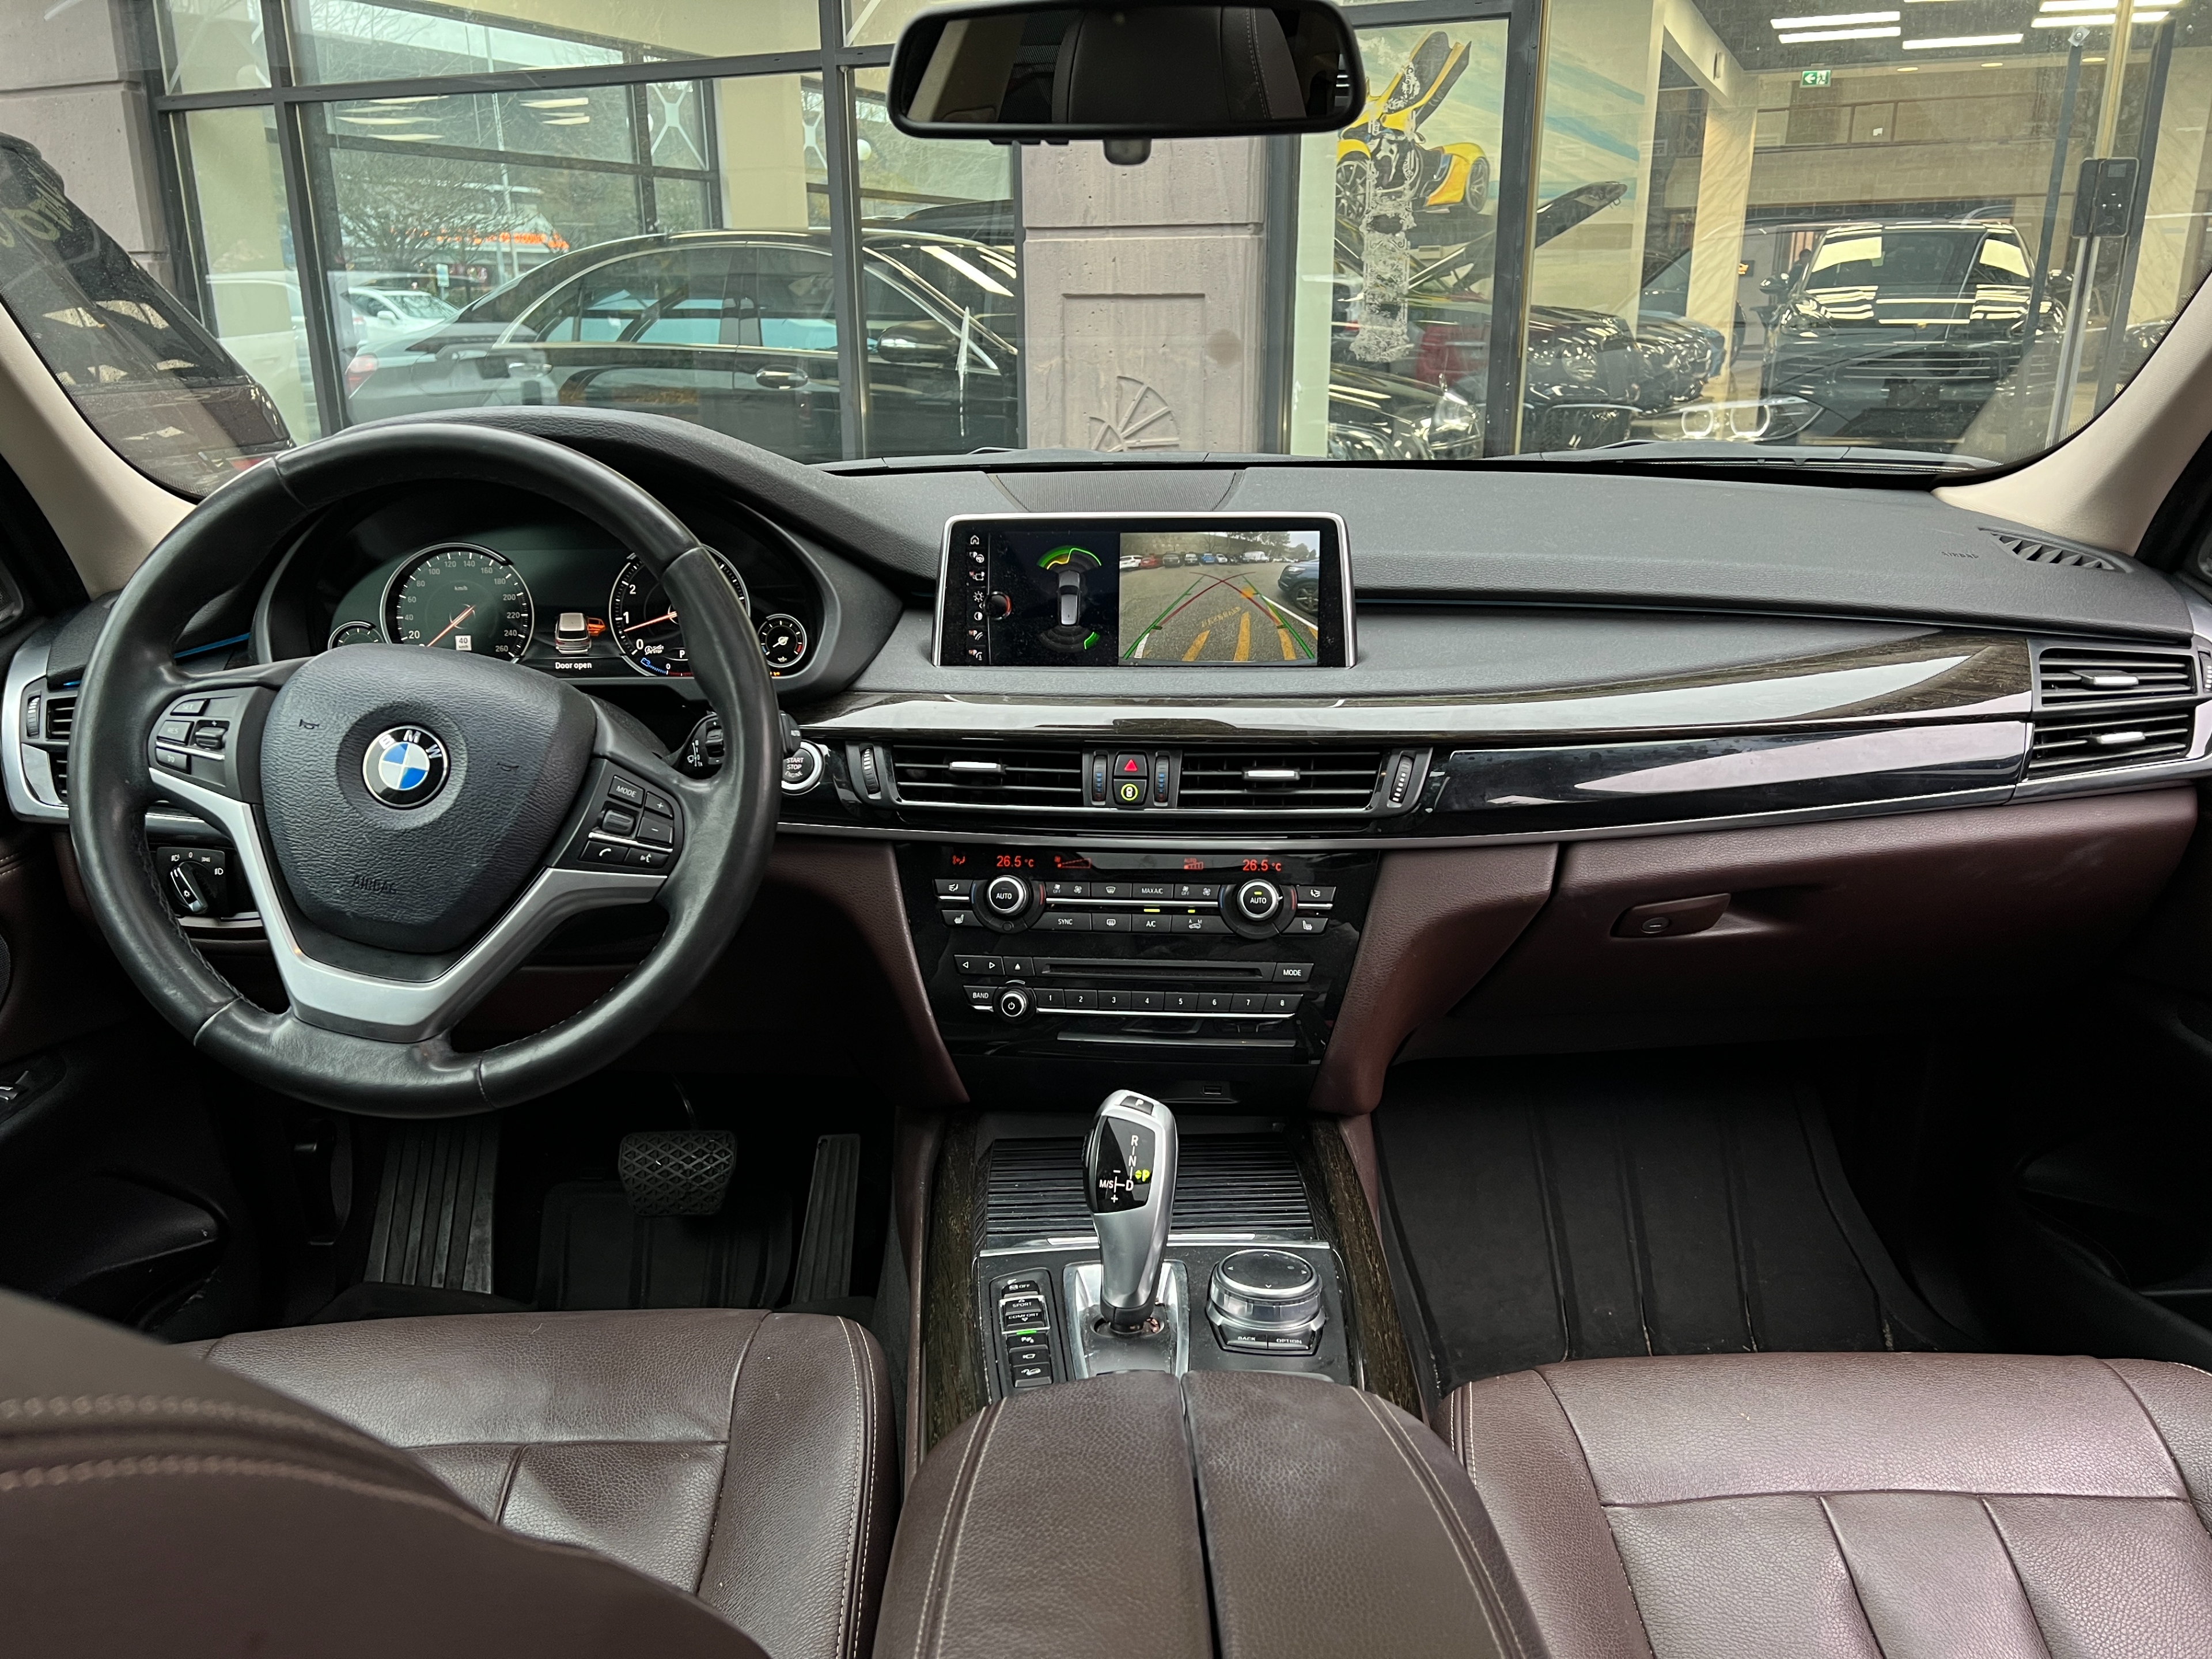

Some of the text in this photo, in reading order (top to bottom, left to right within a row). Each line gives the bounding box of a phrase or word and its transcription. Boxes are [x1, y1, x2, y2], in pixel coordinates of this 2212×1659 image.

[629, 585, 636, 594] 2
[623, 612, 630, 624] 1
[408, 631, 420, 639] 20
[636, 639, 643, 650] 0
[679, 650, 685, 658] P
[378, 729, 442, 759] BMW
[616, 785, 637, 798] MODE
[996, 855, 1022, 868] 26.5
[1242, 858, 1268, 871] 26.5
[1131, 1135, 1139, 1146] R
[1128, 1156, 1137, 1167] N
[1142, 1169, 1150, 1181] P
[1099, 1179, 1113, 1188] M/S
[1126, 1180, 1134, 1191] D
